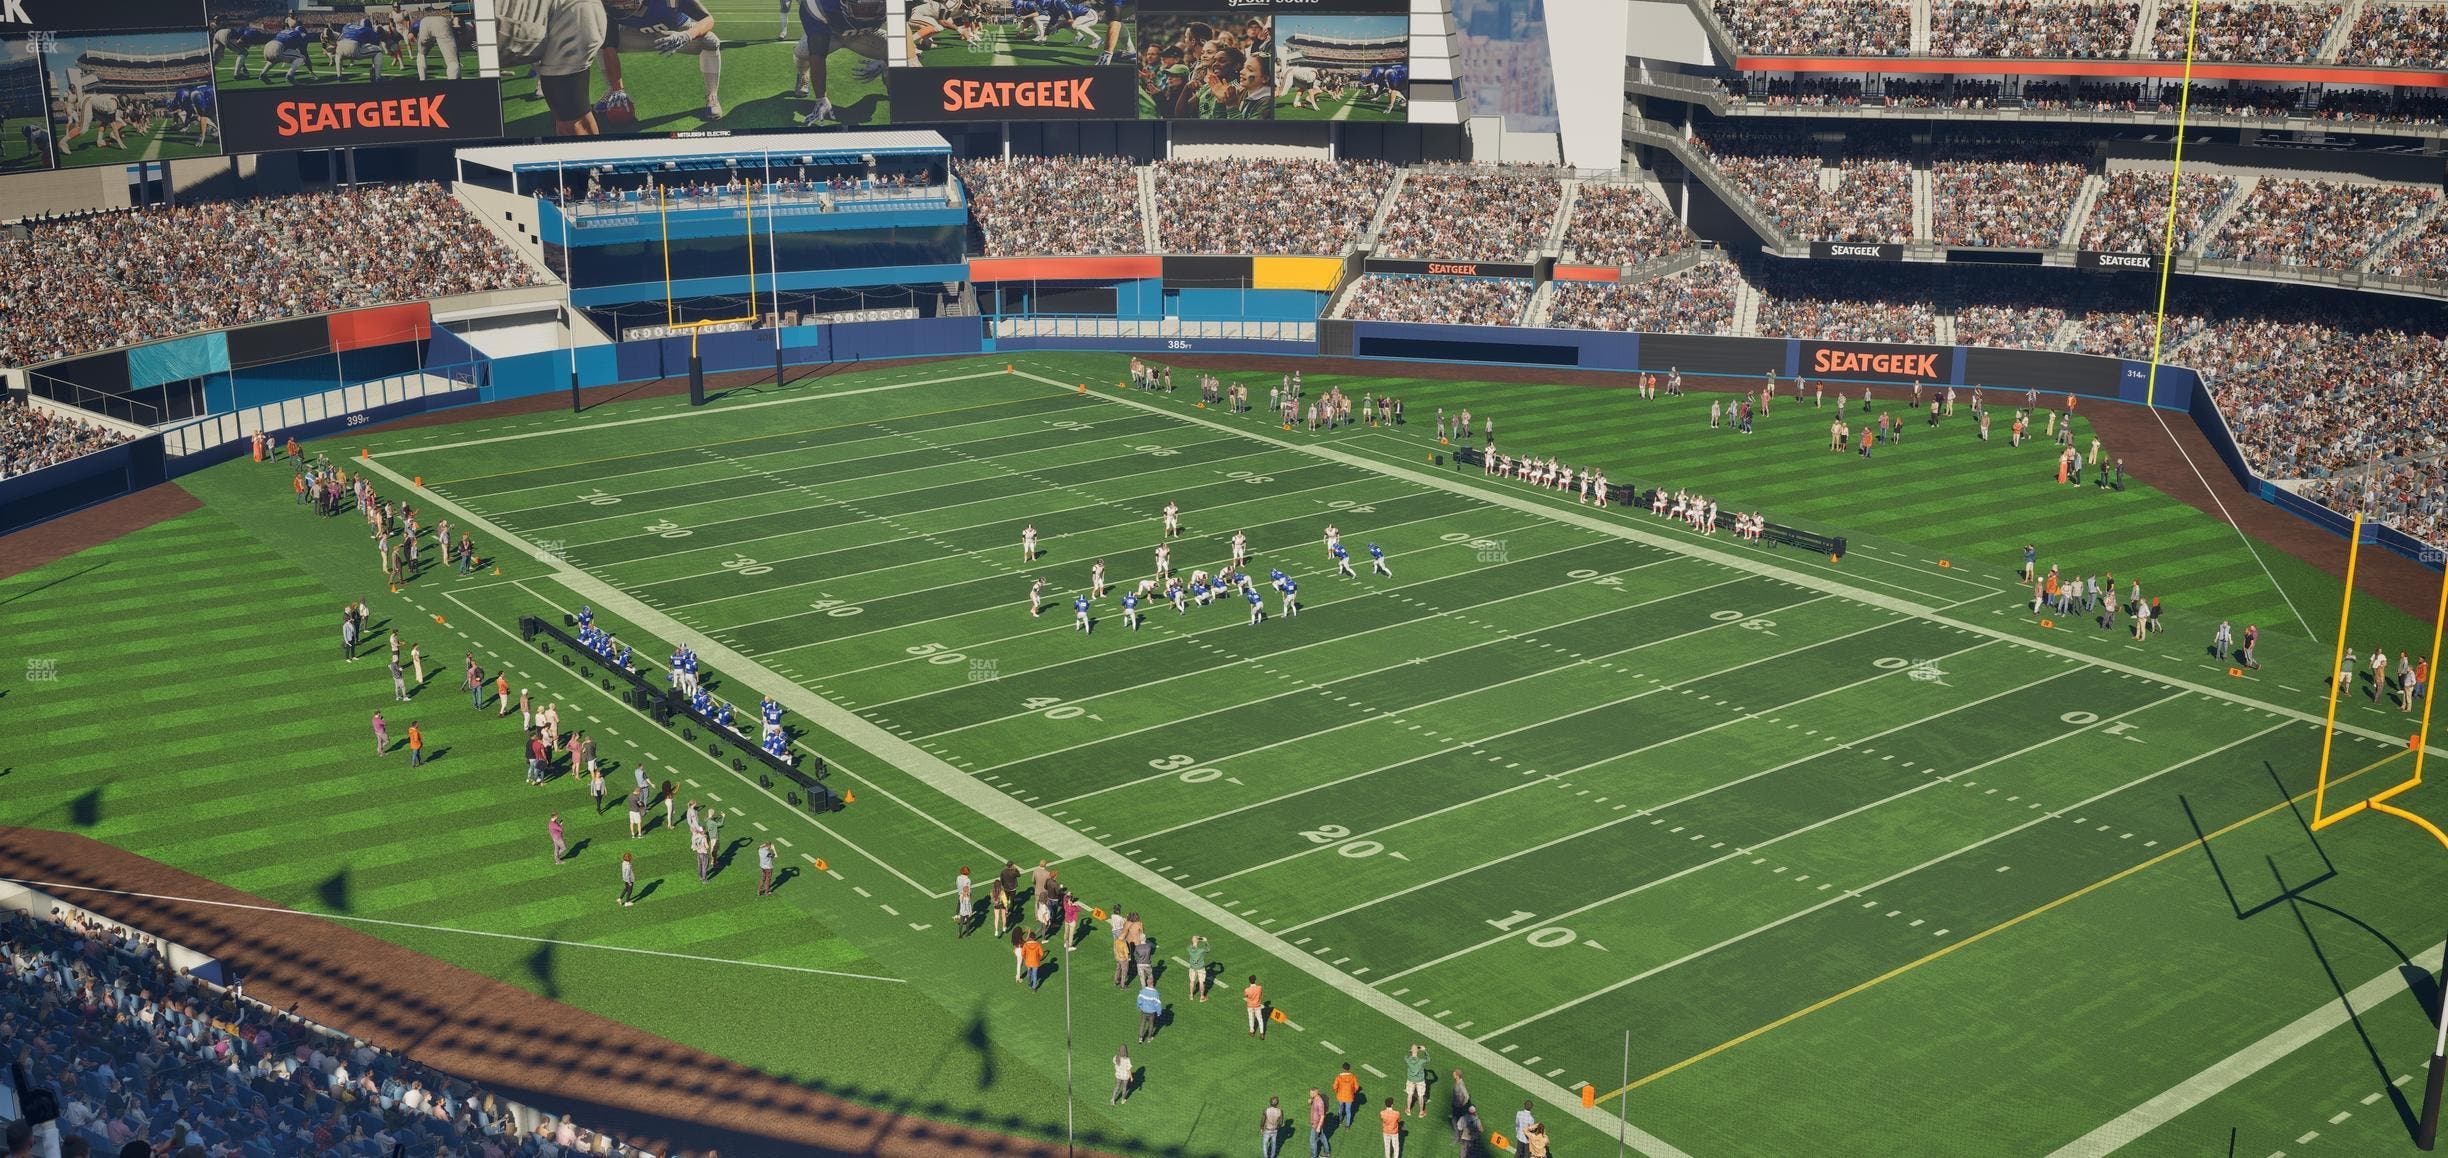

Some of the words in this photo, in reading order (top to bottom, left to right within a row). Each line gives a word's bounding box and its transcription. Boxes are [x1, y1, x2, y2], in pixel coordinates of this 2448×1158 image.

[942, 77, 1096, 112] SEATGEEK
[276, 94, 449, 137] SEATGEEK
[1831, 244, 1881, 258] SEATGEEK
[2099, 254, 2151, 268] SEATGEEK
[1428, 262, 1477, 276] SEATGEEK
[1814, 348, 1939, 379] SEATGEEK
